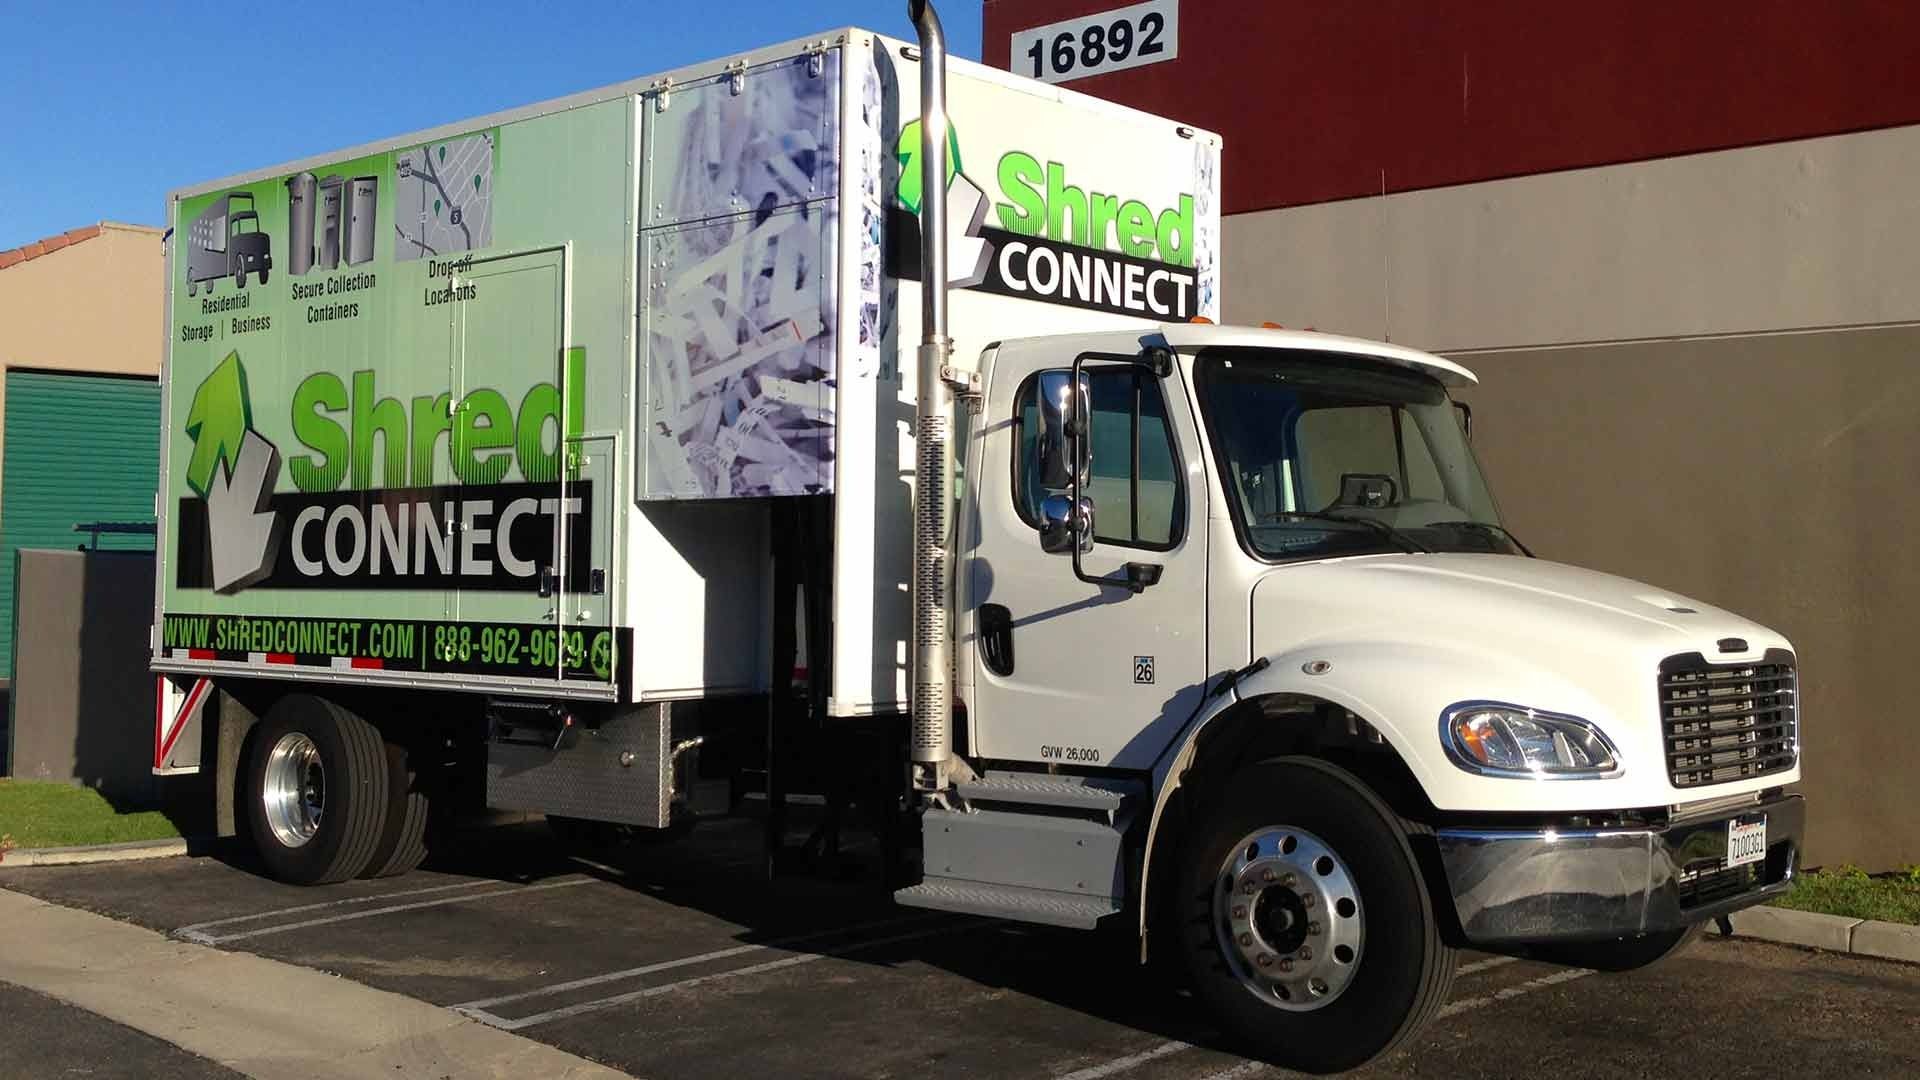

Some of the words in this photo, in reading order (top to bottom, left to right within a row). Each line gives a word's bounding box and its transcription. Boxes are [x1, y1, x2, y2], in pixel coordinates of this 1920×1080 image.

[1027, 12, 1165, 79] 16892
[996, 151, 1194, 269] Shred
[292, 282, 324, 300] Secure
[327, 272, 376, 295] Collection
[999, 242, 1194, 318] CONNECT
[202, 292, 250, 315] Residential
[307, 301, 359, 324] Containers
[182, 325, 213, 342] Storage
[232, 315, 271, 335] Business
[288, 347, 586, 493] Shred
[291, 498, 582, 578] CONNECT
[163, 617, 414, 660] WWW.SHREDCONNECT.COM
[1136, 663, 1153, 681] 26
[1040, 745, 1063, 759] GVW
[1066, 746, 1100, 762] 26,000
